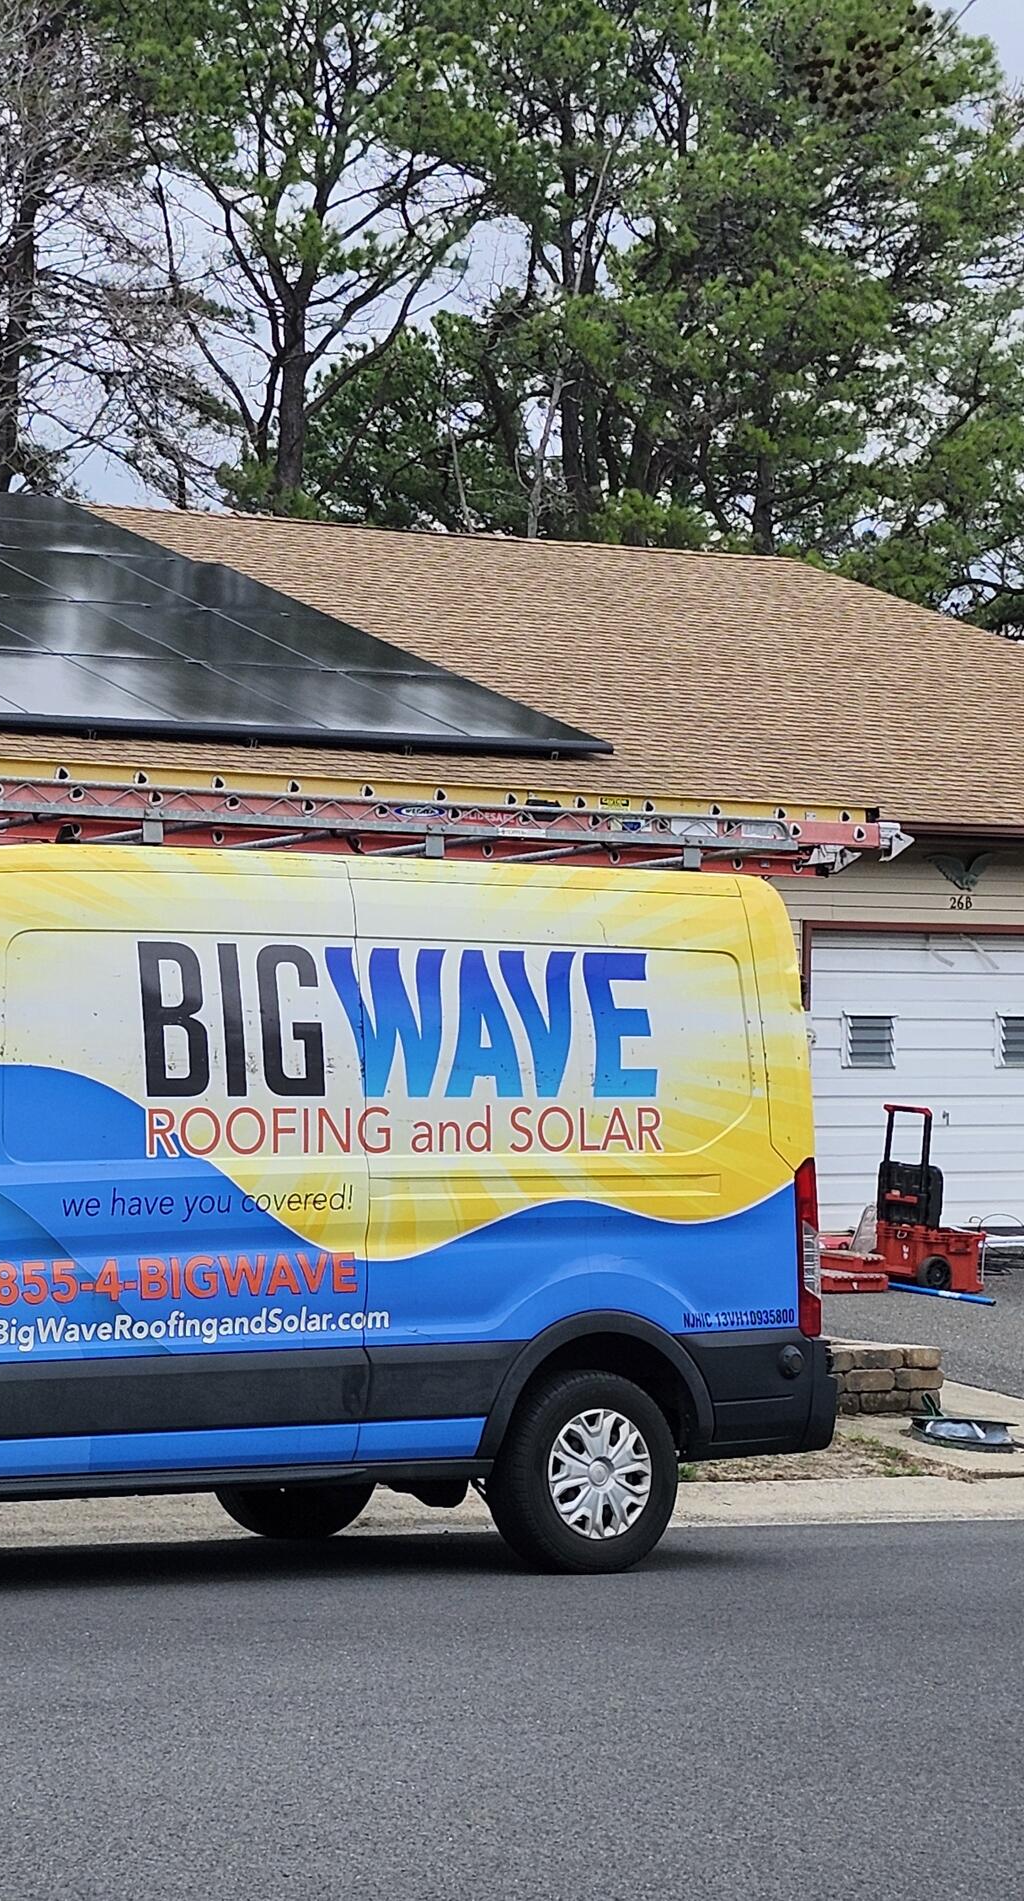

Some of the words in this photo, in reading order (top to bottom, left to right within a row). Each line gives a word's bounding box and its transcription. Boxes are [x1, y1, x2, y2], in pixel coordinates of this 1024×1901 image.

[949, 895, 973, 910] 26B
[148, 1107, 392, 1156] ROOFING
[411, 1105, 491, 1153] and
[510, 1106, 662, 1153] SOLAR
[62, 1195, 101, 1217] we
[111, 1187, 175, 1217] have
[181, 1194, 232, 1223] you
[242, 1183, 354, 1213] covered!
[715, 1308, 795, 1327] 13VH10935800
